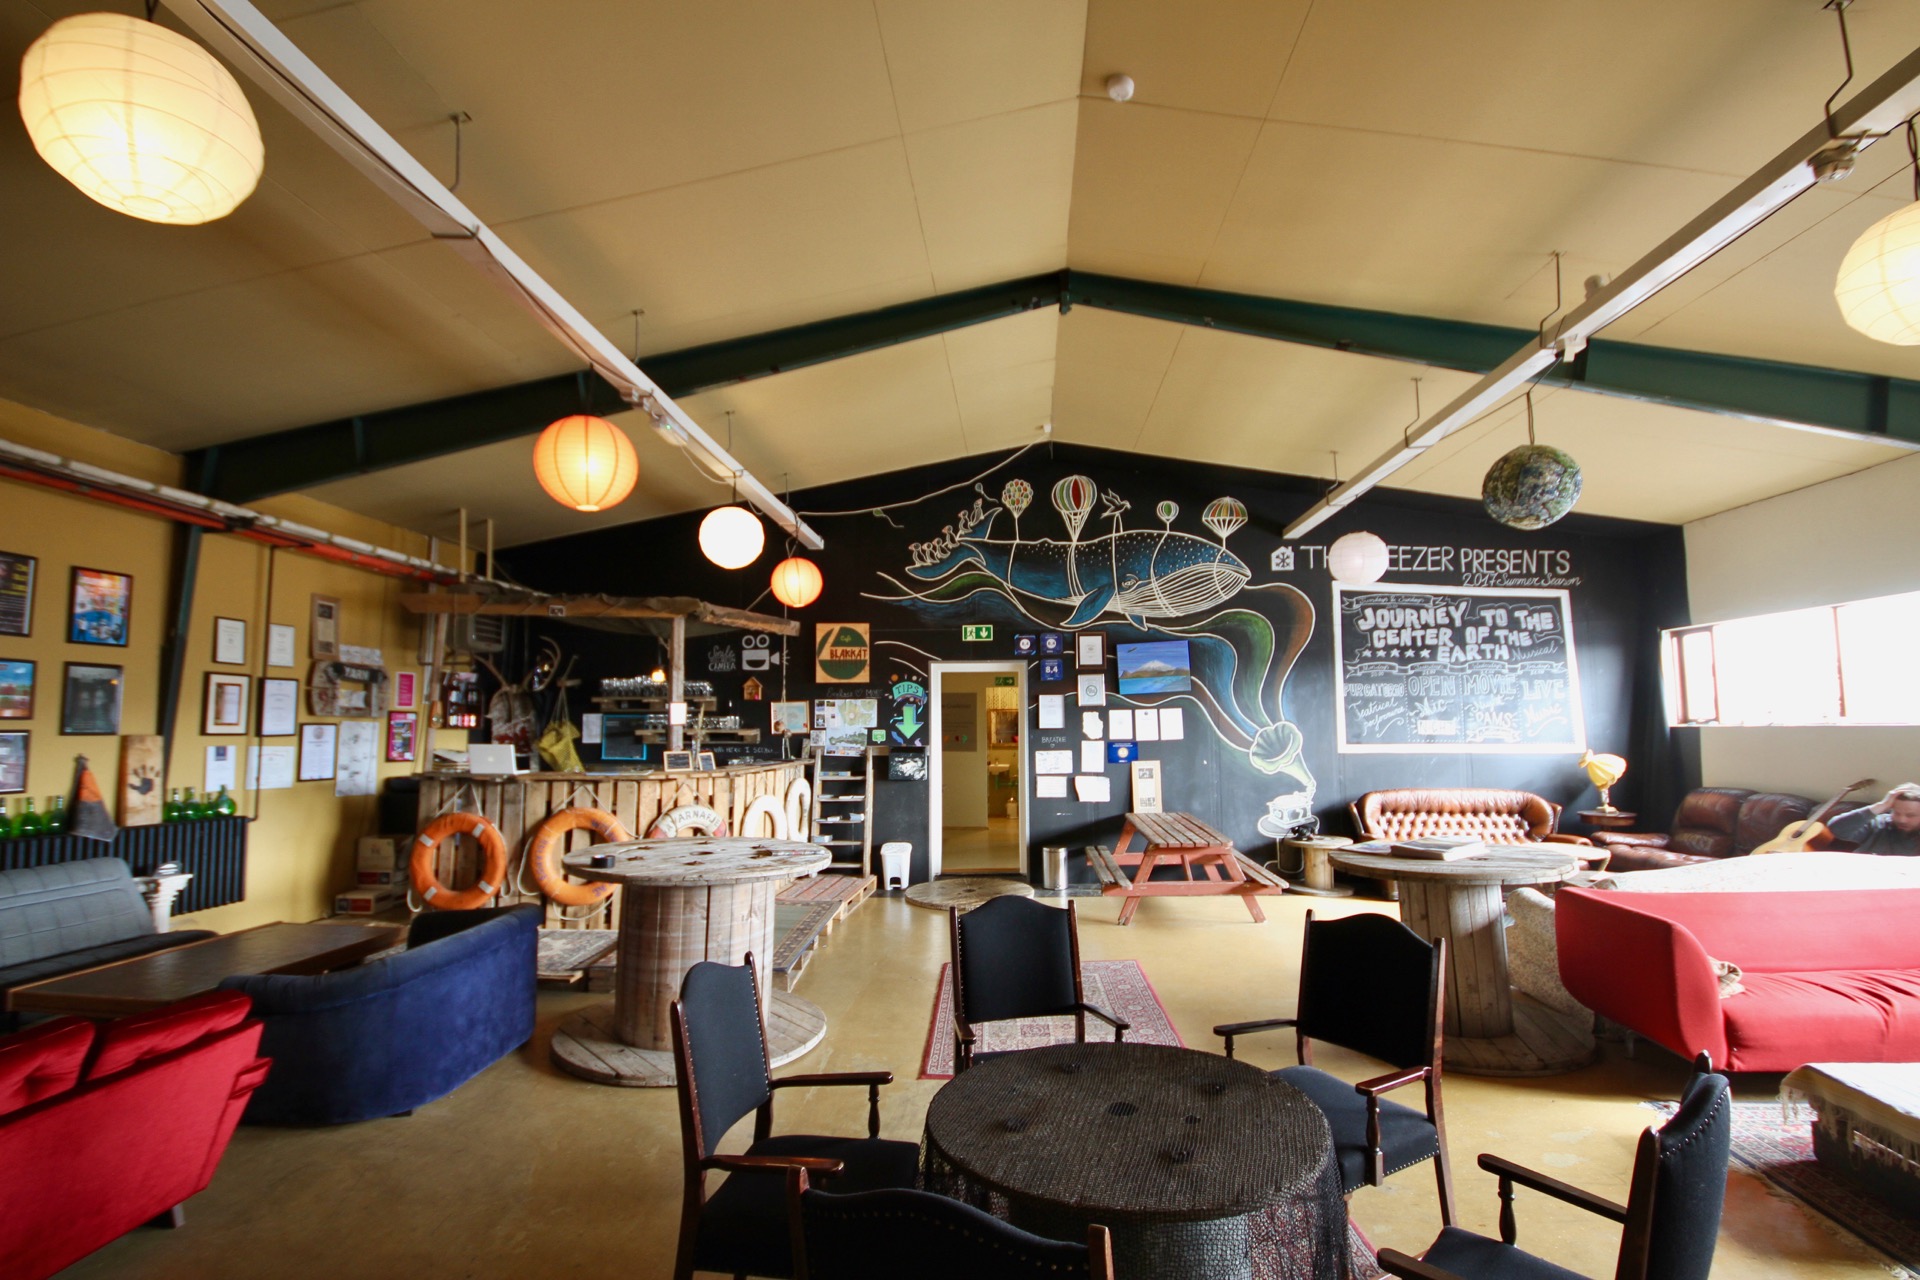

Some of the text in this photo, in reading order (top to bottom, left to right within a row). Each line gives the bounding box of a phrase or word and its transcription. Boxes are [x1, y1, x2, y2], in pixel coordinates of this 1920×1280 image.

[1388, 545, 1455, 571] EEZER
[1460, 547, 1570, 575] PRESENTS
[1462, 572, 1581, 587] 2017 Summer Season
[1358, 601, 1554, 632] JOURNEY TO THE
[1373, 626, 1533, 649] CENTER OF THE
[1437, 643, 1510, 664] EARTH
[1045, 665, 1059, 675] 8,4
[895, 683, 920, 695] TIPS
[1408, 675, 1456, 697] OPEN
[1463, 674, 1516, 695] MOVIE
